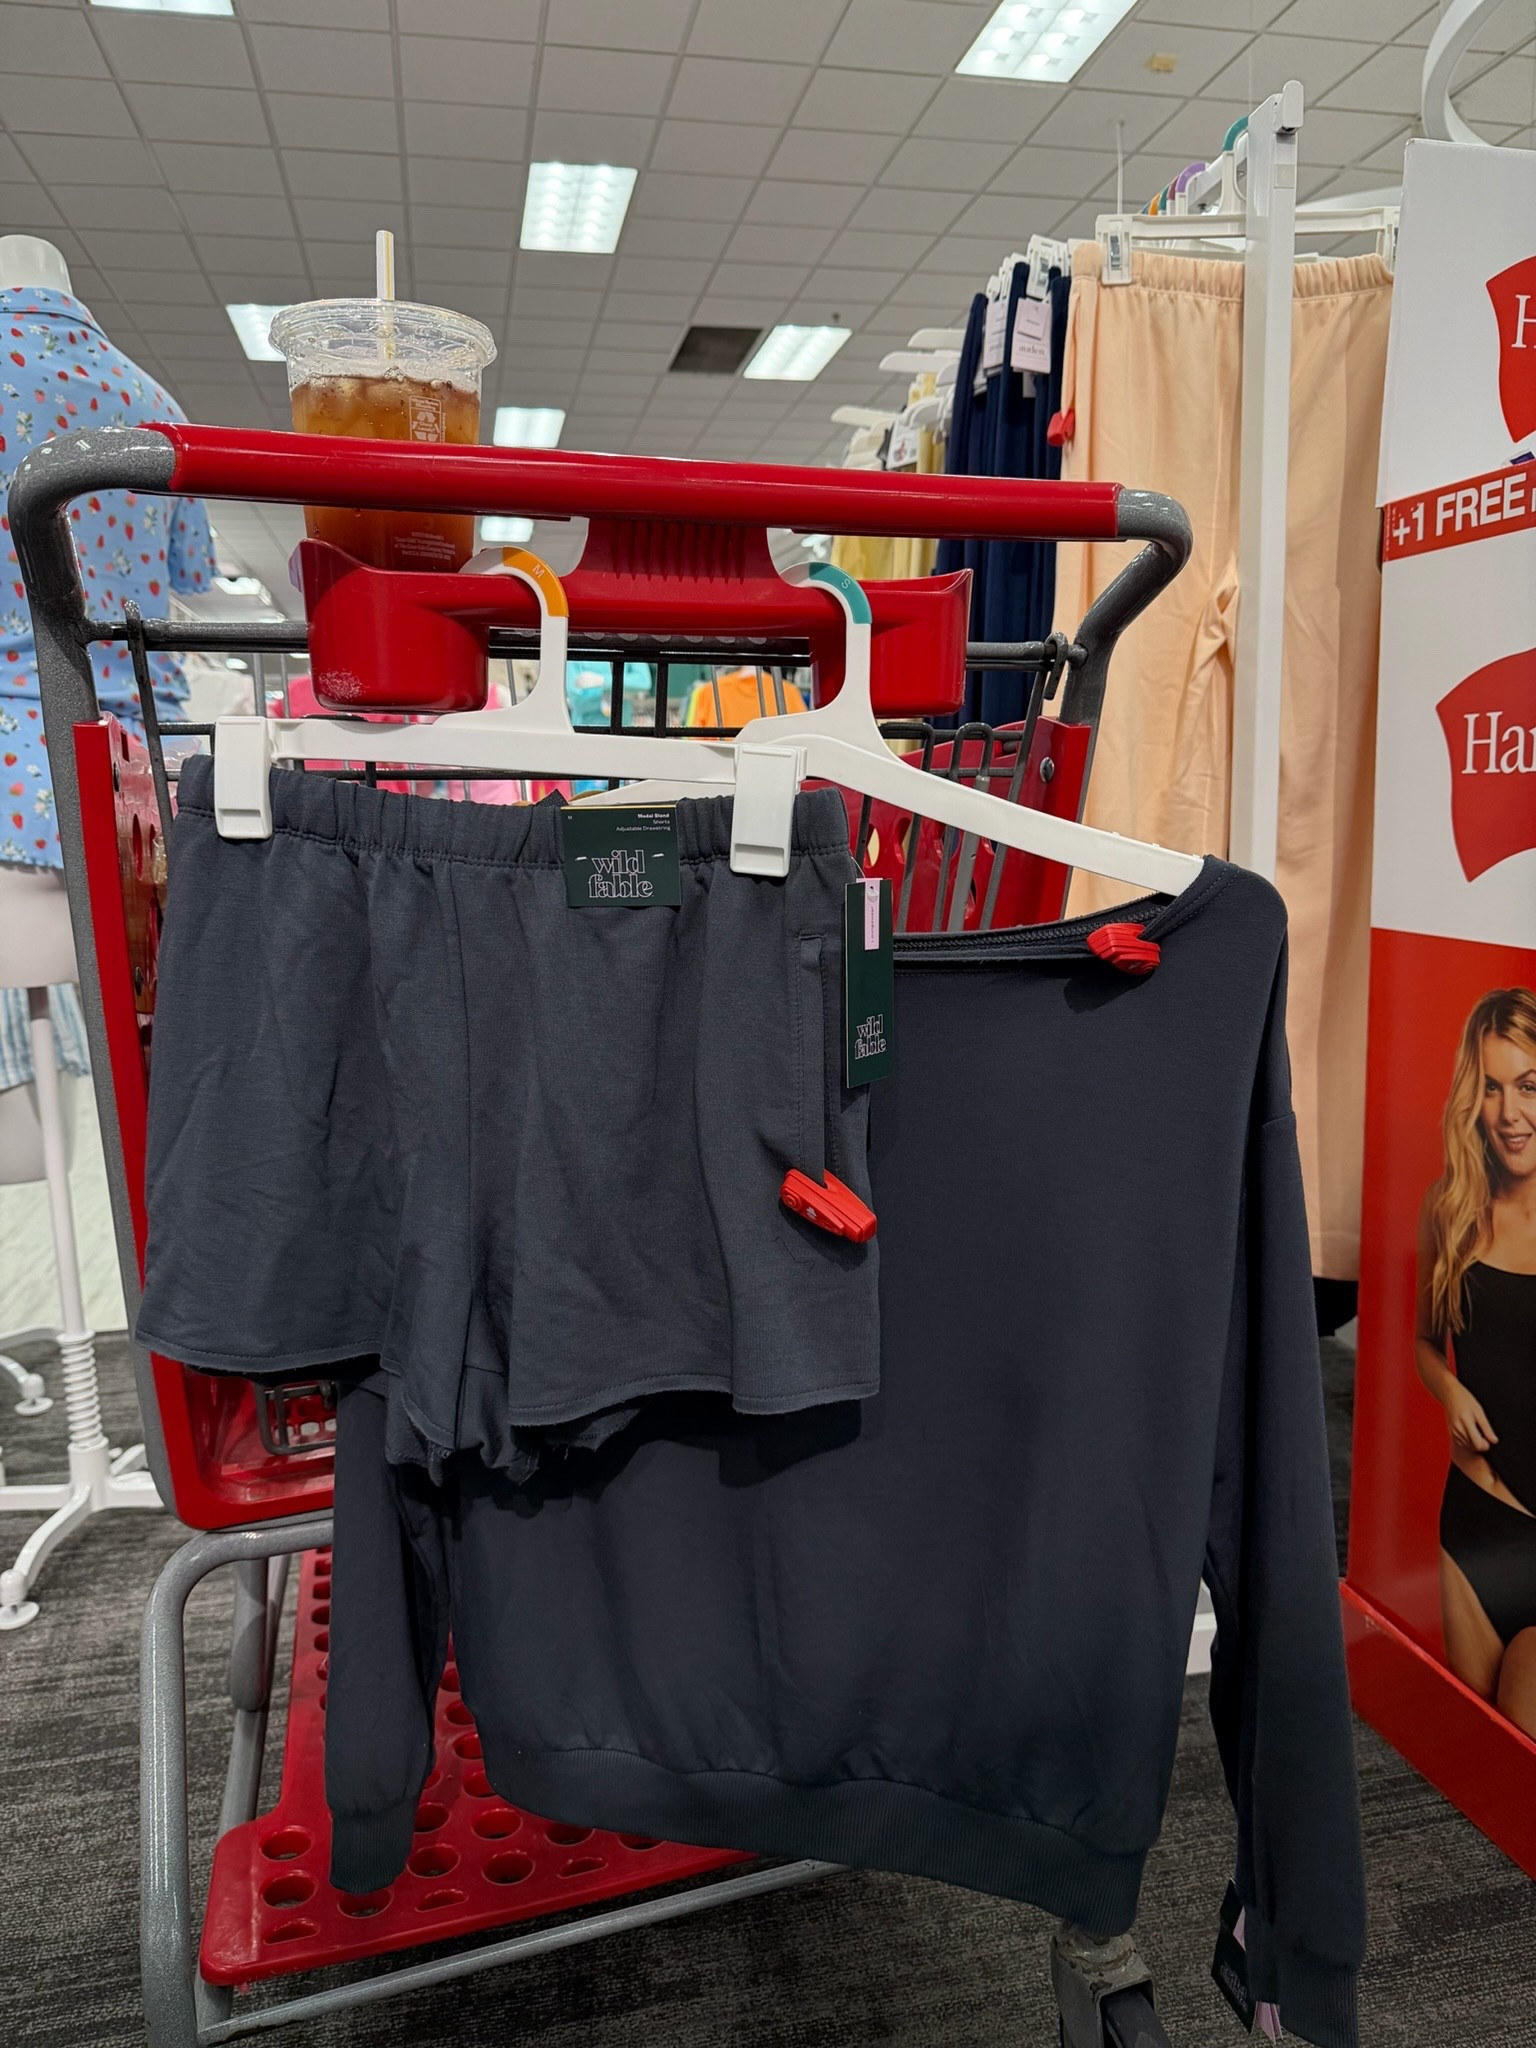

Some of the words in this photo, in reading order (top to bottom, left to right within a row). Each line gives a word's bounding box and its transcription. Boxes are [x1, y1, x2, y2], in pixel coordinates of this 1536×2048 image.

[1392, 502, 1424, 546] +1
[1435, 472, 1527, 537] FREE
[532, 559, 545, 578] M
[841, 578, 851, 590] S
[591, 850, 645, 874] wild
[588, 874, 653, 898] fable
[856, 1013, 883, 1038] wild
[854, 1034, 887, 1060] fable
